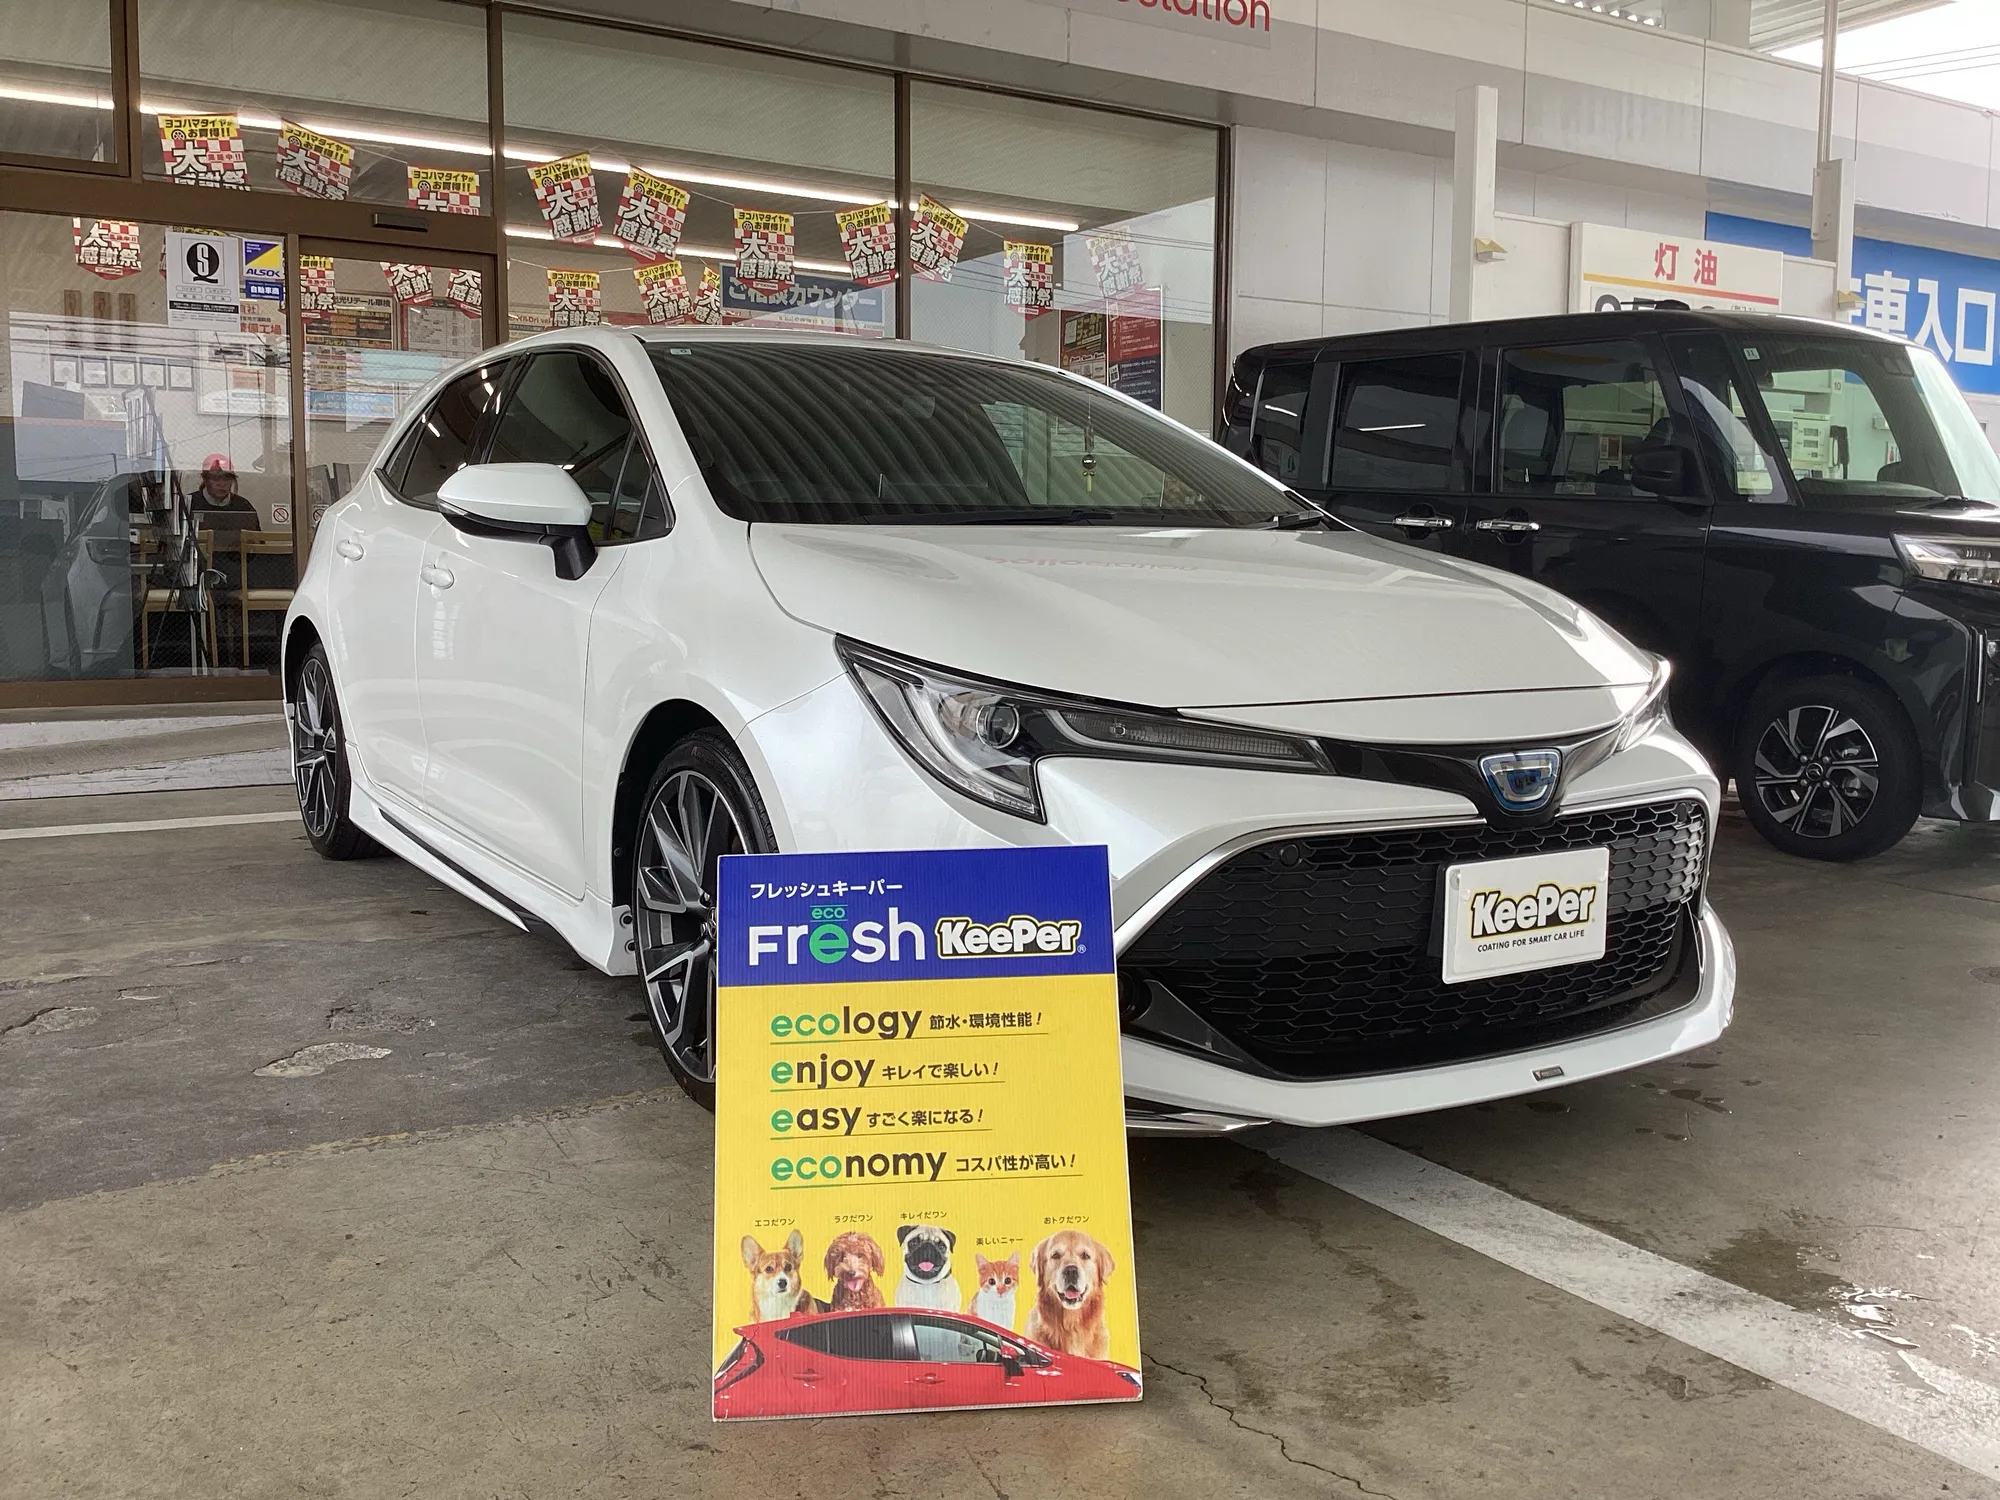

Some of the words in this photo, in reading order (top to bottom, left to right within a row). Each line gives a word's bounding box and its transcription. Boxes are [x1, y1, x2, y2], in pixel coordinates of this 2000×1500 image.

[172, 140, 207, 175] 大
[282, 148, 316, 175] 大
[546, 184, 577, 219] 大
[622, 195, 656, 226] 大
[618, 219, 676, 254] 感謝祭
[740, 232, 767, 260] 大
[849, 230, 873, 260] 大
[911, 222, 939, 248] 大
[80, 246, 139, 267] 感謝祭
[739, 259, 792, 280] 感謝祭
[910, 242, 955, 275] 感謝祭
[1654, 243, 1718, 286] 灯油
[246, 268, 280, 277] ALSOK
[1009, 263, 1030, 287] 大
[554, 288, 577, 311] 大
[646, 283, 668, 308] 大
[1007, 286, 1052, 306] 感謝祭
[554, 311, 600, 327] 感謝祭
[650, 297, 692, 323] 感謝祭
[1849, 270, 1996, 366] 車入口
[750, 879, 903, 899] フレッシュキーパー
[811, 907, 846, 919] eco
[1471, 884, 1596, 938] KeePer
[749, 907, 925, 966] Fresh
[936, 916, 1081, 958] KeePer
[1478, 941, 1509, 952] COATING
[1512, 938, 1527, 947] FOR
[1529, 935, 1552, 945] SMART
[1554, 932, 1568, 941] CAR
[1569, 929, 1585, 939] LIFE
[771, 1006, 922, 1039] ecology
[930, 1013, 1042, 1030] 節水・環境性能!
[771, 1053, 875, 1089] enjoy
[882, 1063, 998, 1080] キレイで楽しい!
[771, 1107, 862, 1136] easy
[867, 1109, 983, 1127] すごく楽になる!
[771, 1151, 947, 1181] economy
[956, 1154, 1076, 1172] コスパ性が高い!
[755, 1218, 795, 1227] エコだワン
[834, 1214, 873, 1223] ラクだワン
[900, 1211, 948, 1220] キレイだワン
[1044, 1216, 1089, 1224] おトクだワン
[976, 1237, 1023, 1246] 楽しいニャー
